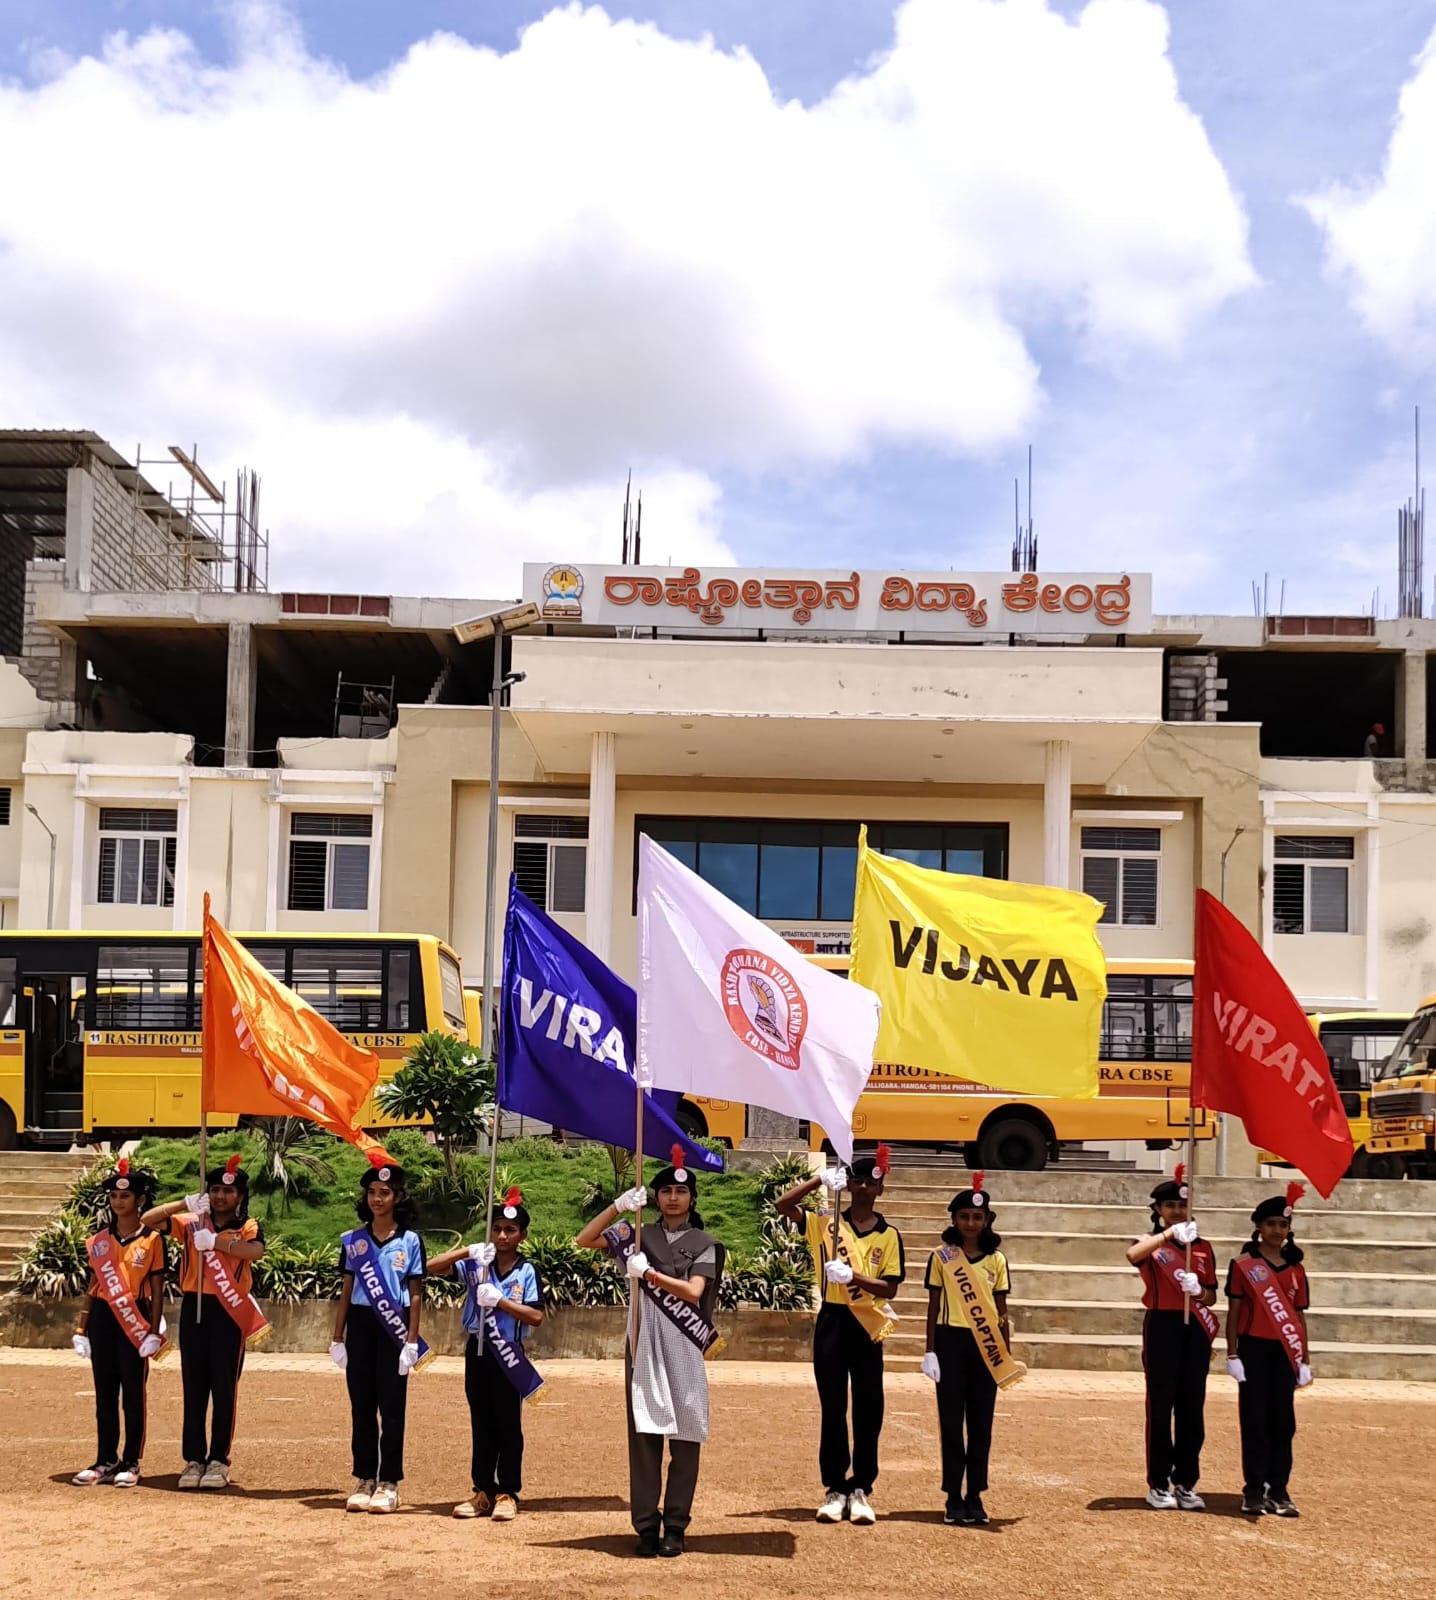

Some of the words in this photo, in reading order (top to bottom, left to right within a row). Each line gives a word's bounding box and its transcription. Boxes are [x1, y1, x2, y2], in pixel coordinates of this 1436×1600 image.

[879, 576, 989, 628] ವಿದ್ಯಾ
[1002, 572, 1132, 626] ಕೇಂದ್ರ
[889, 919, 1079, 1002] VIJAYA
[770, 965, 799, 1001] VIDYA
[90, 1034, 101, 1042] 11
[105, 1033, 203, 1046] RASHTROTT
[363, 1034, 406, 1047] CBSE
[519, 977, 638, 1082] VIRA
[745, 1031, 769, 1055] CBSE
[1129, 1068, 1174, 1082] CBSE
[100, 1260, 124, 1297] VICE
[204, 1250, 244, 1309] APTAIN
[359, 1260, 385, 1299] VICE
[953, 1266, 977, 1304] VICE
[969, 1305, 1004, 1368] CAPTAIN
[1263, 1285, 1289, 1322] VICE
